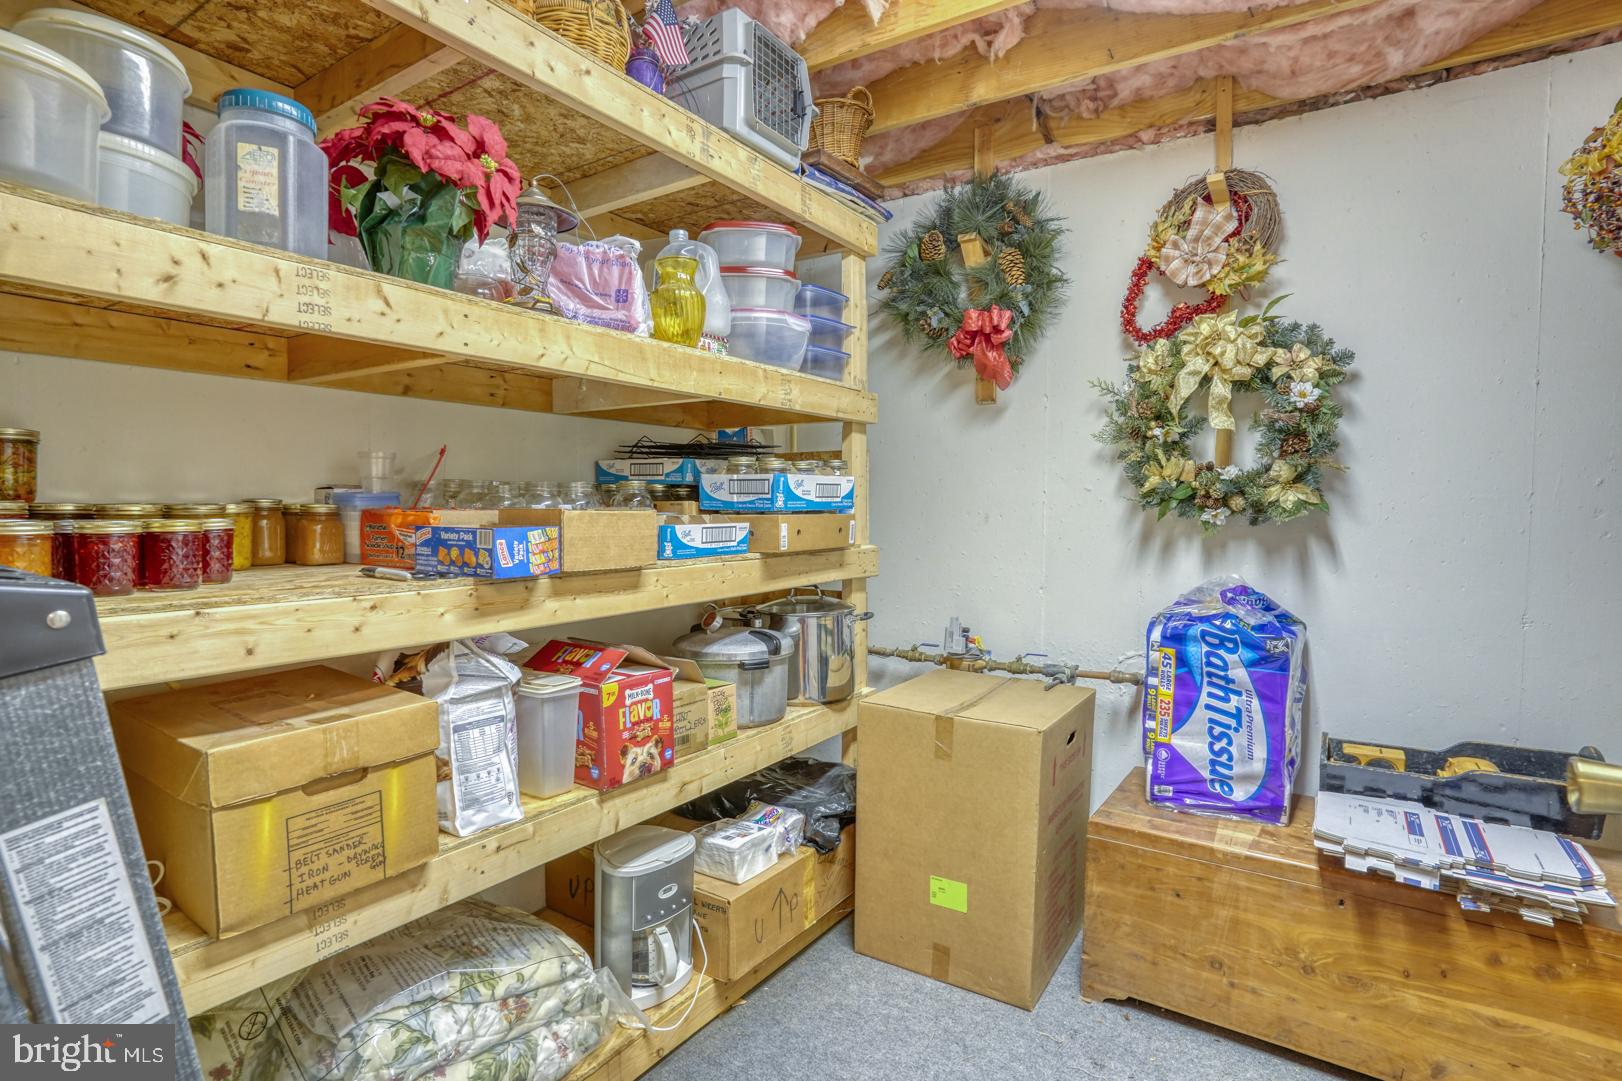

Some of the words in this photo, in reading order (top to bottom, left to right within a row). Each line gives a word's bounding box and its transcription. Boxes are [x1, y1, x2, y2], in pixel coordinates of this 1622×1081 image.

[295, 265, 331, 282] SELECT
[296, 284, 331, 299] SELECT
[297, 301, 332, 317] SELECT
[440, 531, 459, 540] Variety
[460, 532, 473, 540] Pack
[1160, 652, 1171, 670] 45
[1159, 699, 1171, 717] 235
[1246, 714, 1255, 761] Premium
[297, 864, 329, 884] IRON
[296, 878, 326, 900] HEAT
[328, 871, 352, 885] GUN
[313, 917, 348, 937] SELECT
[315, 930, 349, 953] SELECT
